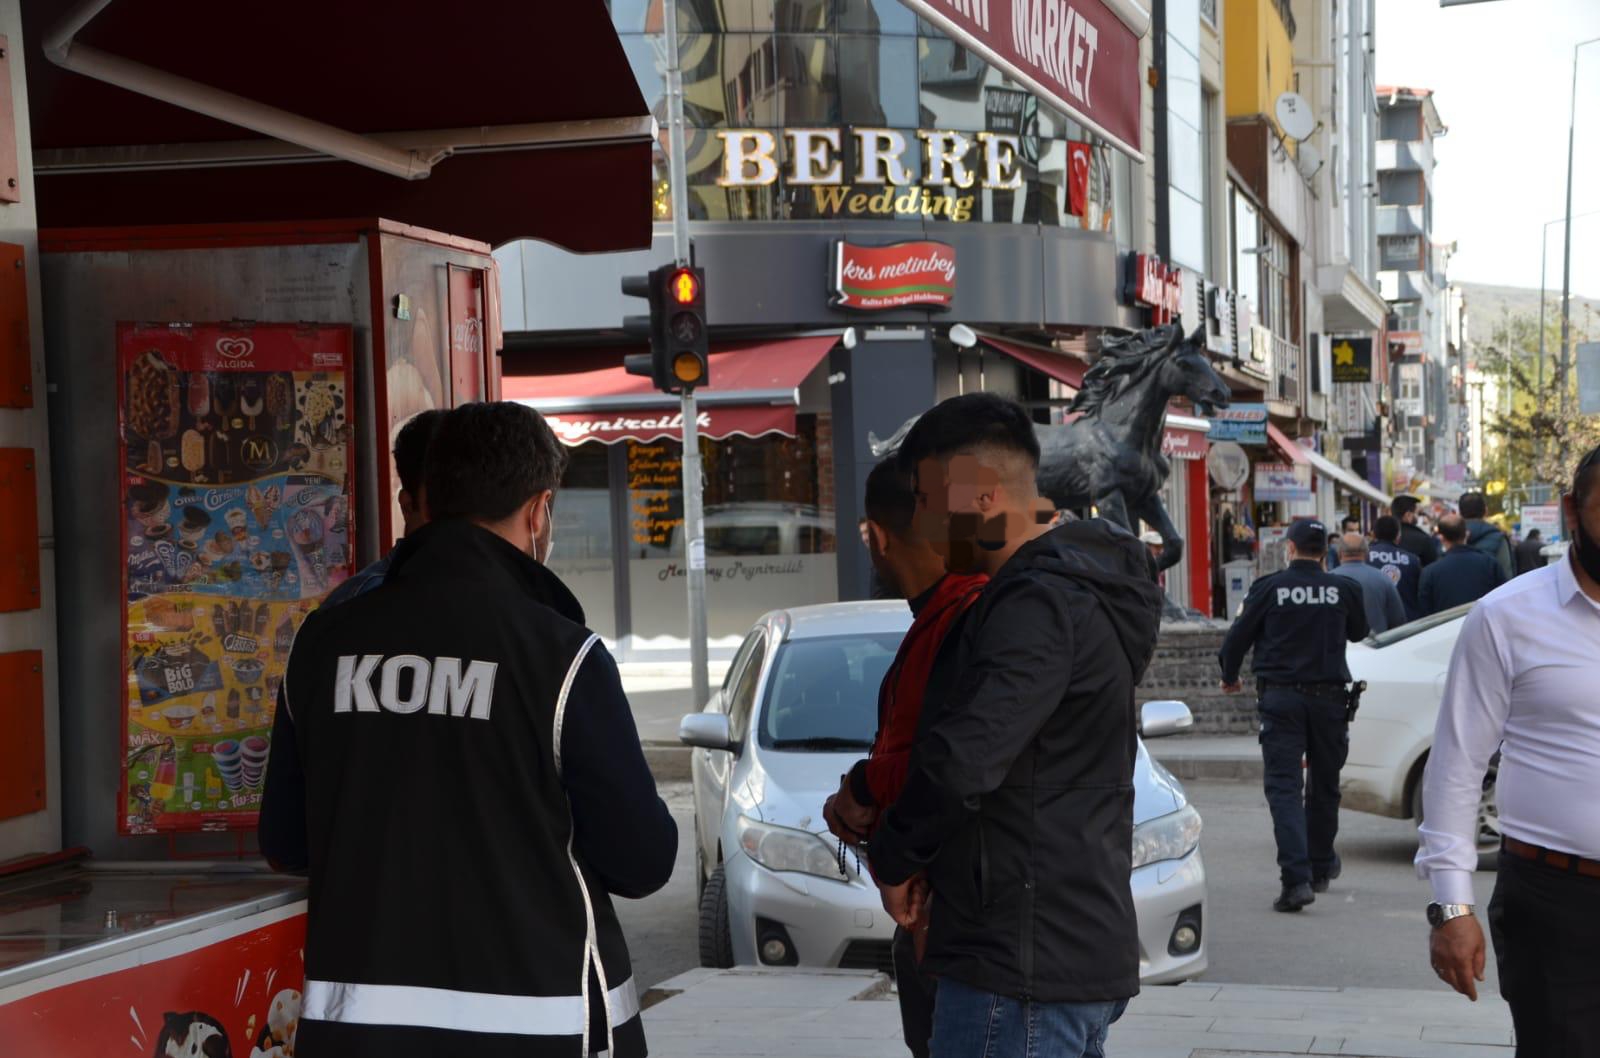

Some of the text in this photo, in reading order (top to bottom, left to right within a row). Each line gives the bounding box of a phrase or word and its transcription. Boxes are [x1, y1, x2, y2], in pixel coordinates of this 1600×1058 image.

[1011, 0, 1098, 108] MARKET
[717, 129, 1025, 190] BERRE
[811, 184, 974, 222] Wedding
[879, 252, 956, 282] metinbey
[215, 360, 256, 369] ALGIDA
[168, 680, 194, 694] BOLD
[334, 654, 499, 720] KOM
